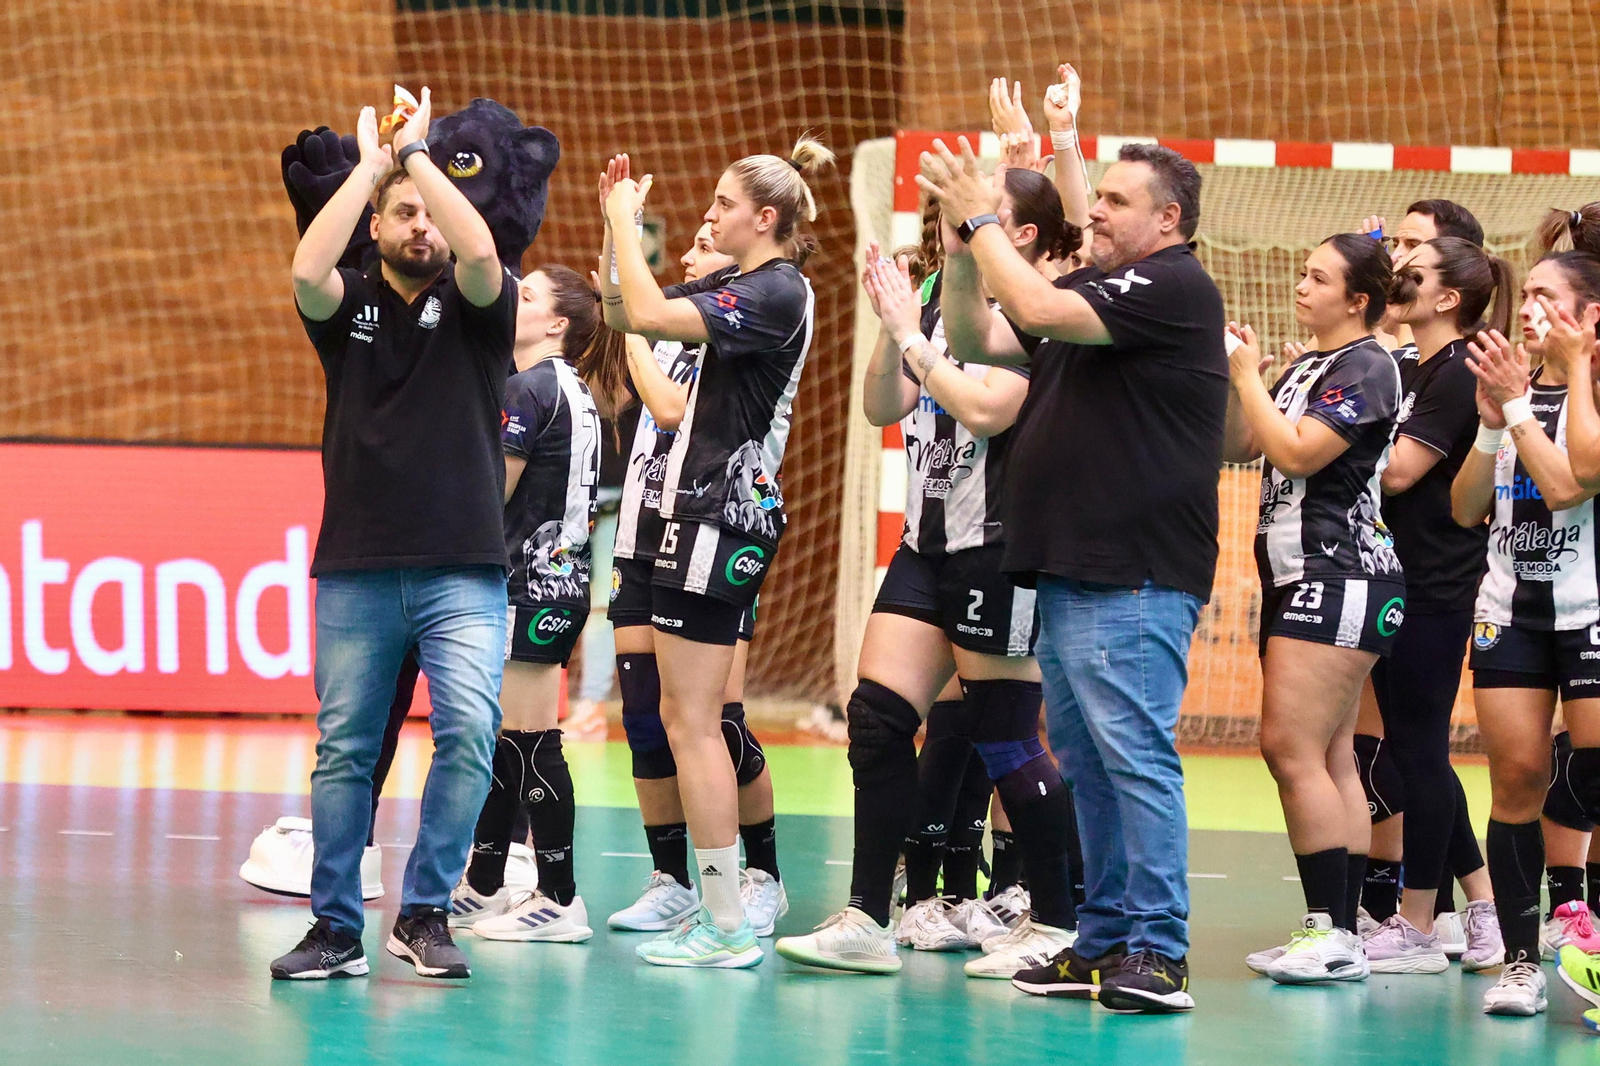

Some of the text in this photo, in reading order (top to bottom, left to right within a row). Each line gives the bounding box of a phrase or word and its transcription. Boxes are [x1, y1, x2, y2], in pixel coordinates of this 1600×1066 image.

[659, 521, 681, 555] 15
[1491, 520, 1581, 563] Málaga
[734, 556, 765, 577] CSIF
[1512, 561, 1562, 573] DE MODA
[0, 518, 311, 679] tand
[967, 588, 985, 622] 2
[1290, 581, 1325, 610] 23
[537, 614, 572, 634] CSIF
